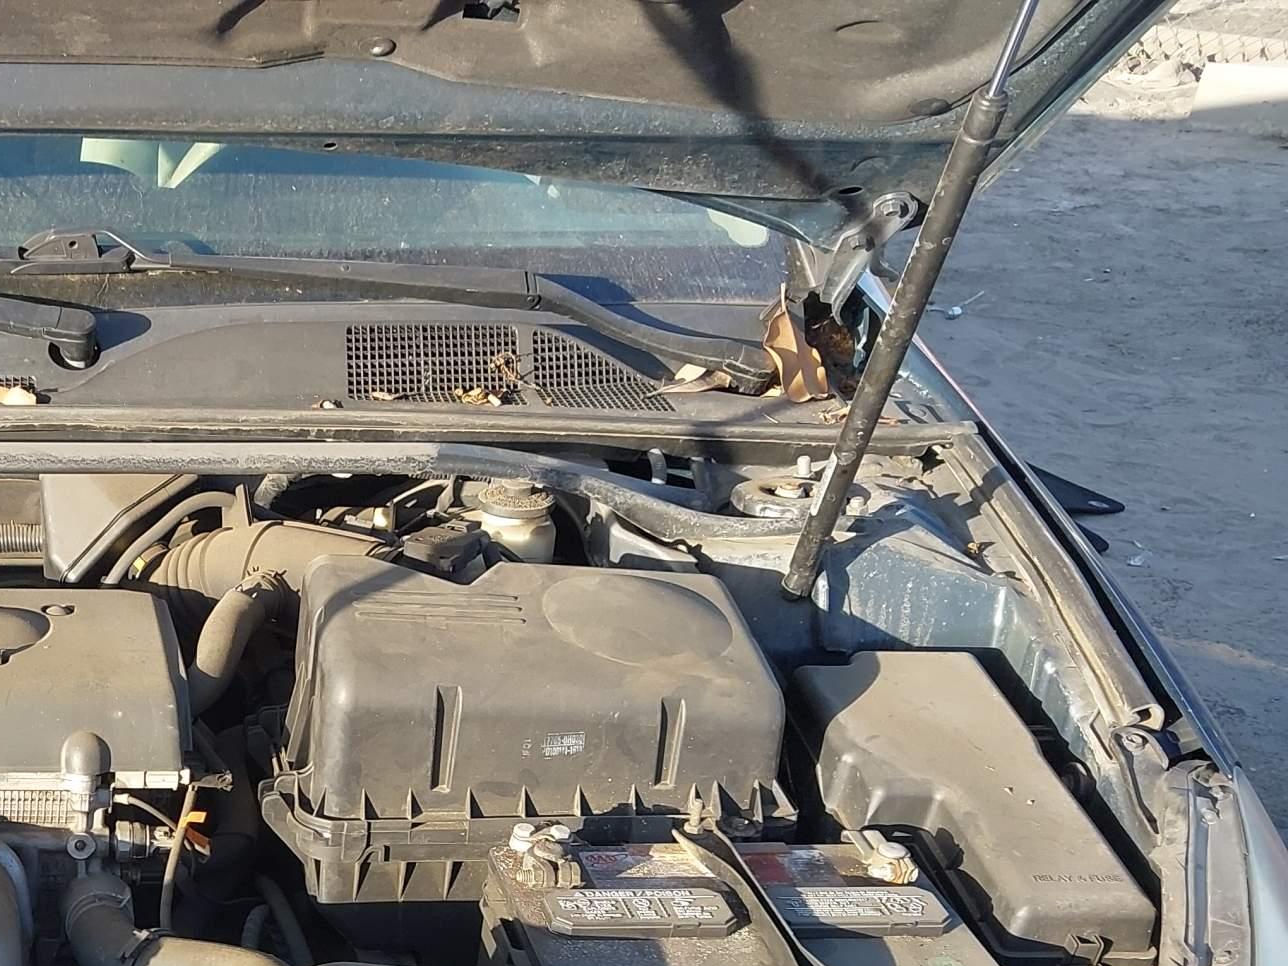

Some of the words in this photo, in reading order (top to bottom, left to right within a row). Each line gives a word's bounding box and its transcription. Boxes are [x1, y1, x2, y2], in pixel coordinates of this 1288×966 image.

[1031, 874, 1074, 883] RELAY
[1088, 874, 1123, 883] FUSE
[585, 890, 635, 898] DANGER
[648, 890, 691, 898] POISON
